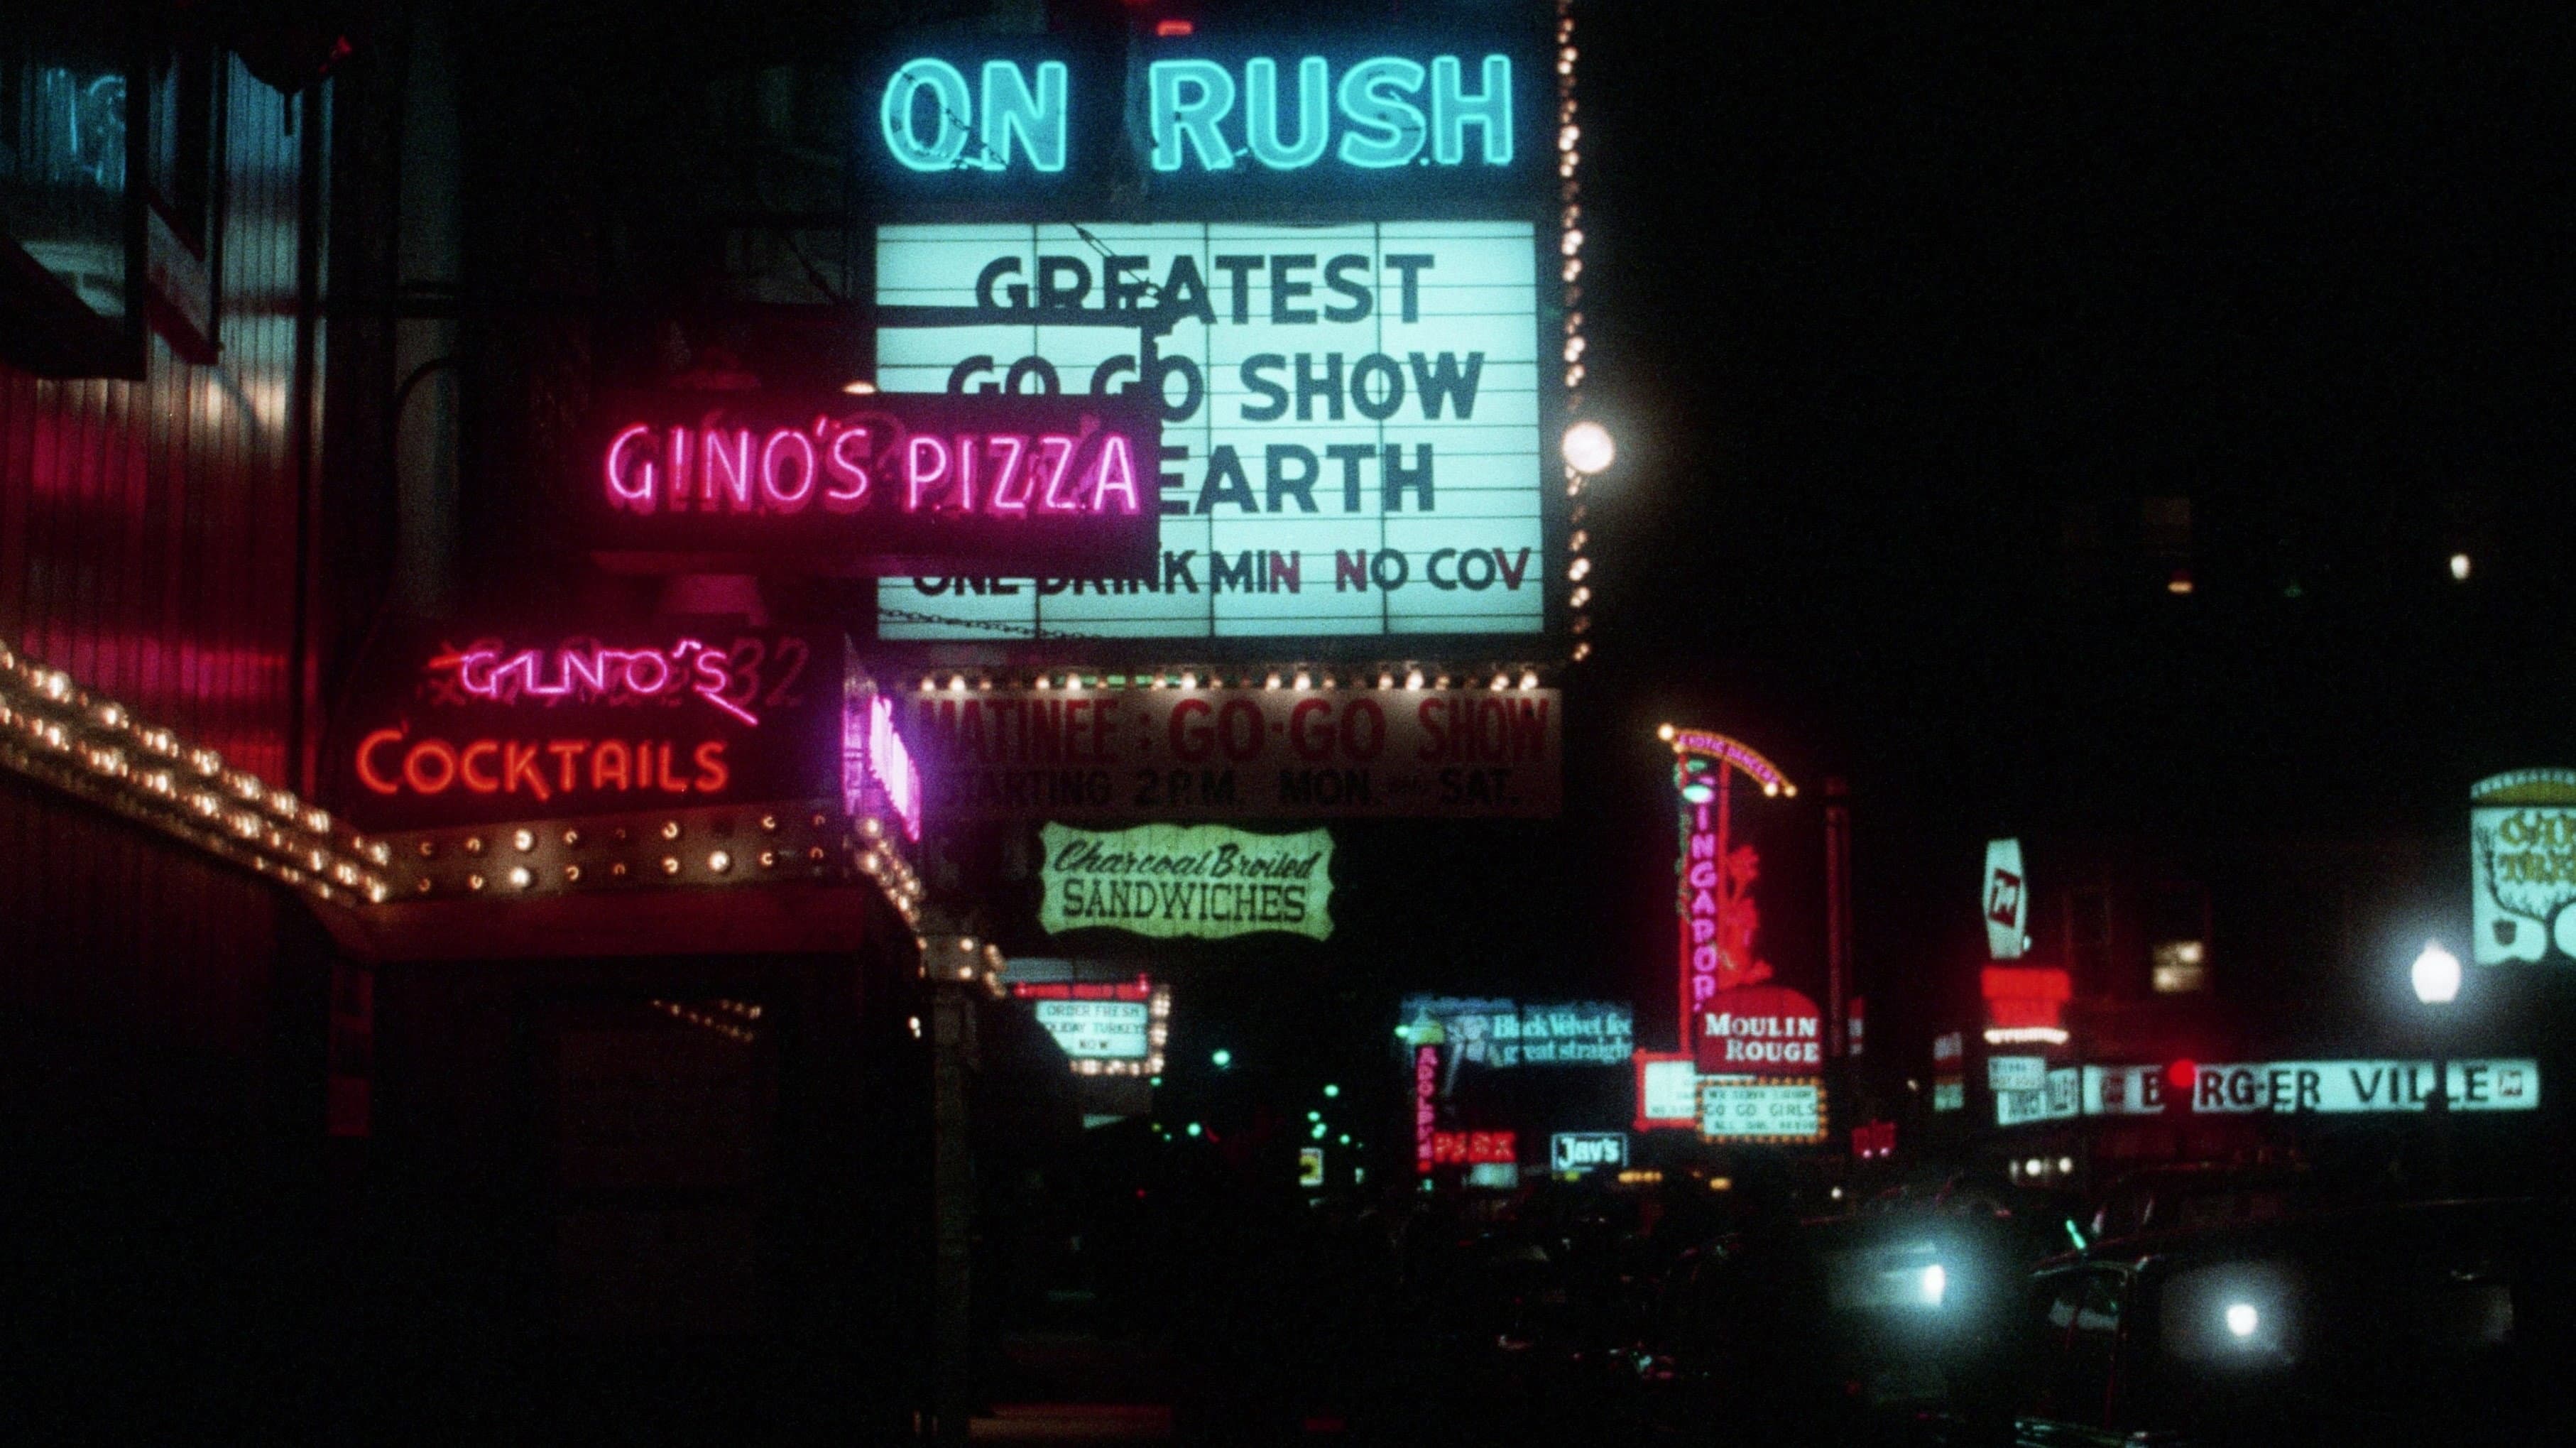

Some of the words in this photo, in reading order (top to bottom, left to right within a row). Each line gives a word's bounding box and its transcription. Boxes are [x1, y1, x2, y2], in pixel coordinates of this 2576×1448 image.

[881, 58, 1067, 170] ON
[1149, 55, 1514, 170] RUSH
[976, 254, 1434, 324] GREATEST
[1238, 351, 1485, 420] SHOW
[607, 417, 869, 506] GINO'S
[908, 435, 1139, 511] PIZZA
[1158, 443, 1434, 516] EARTH
[1212, 548, 1300, 594] MIN
[1336, 548, 1409, 593] NO
[1426, 546, 1531, 592] COV
[1417, 697, 1549, 763] SHOW
[356, 729, 730, 801] COCKTAILS
[1055, 839, 1210, 874] Charcoal
[1210, 843, 1323, 878] Broiled
[1063, 878, 1306, 922] SANDWICHES
[1705, 1012, 1818, 1037] MOULIN
[1725, 1038, 1821, 1062] ROUGE
